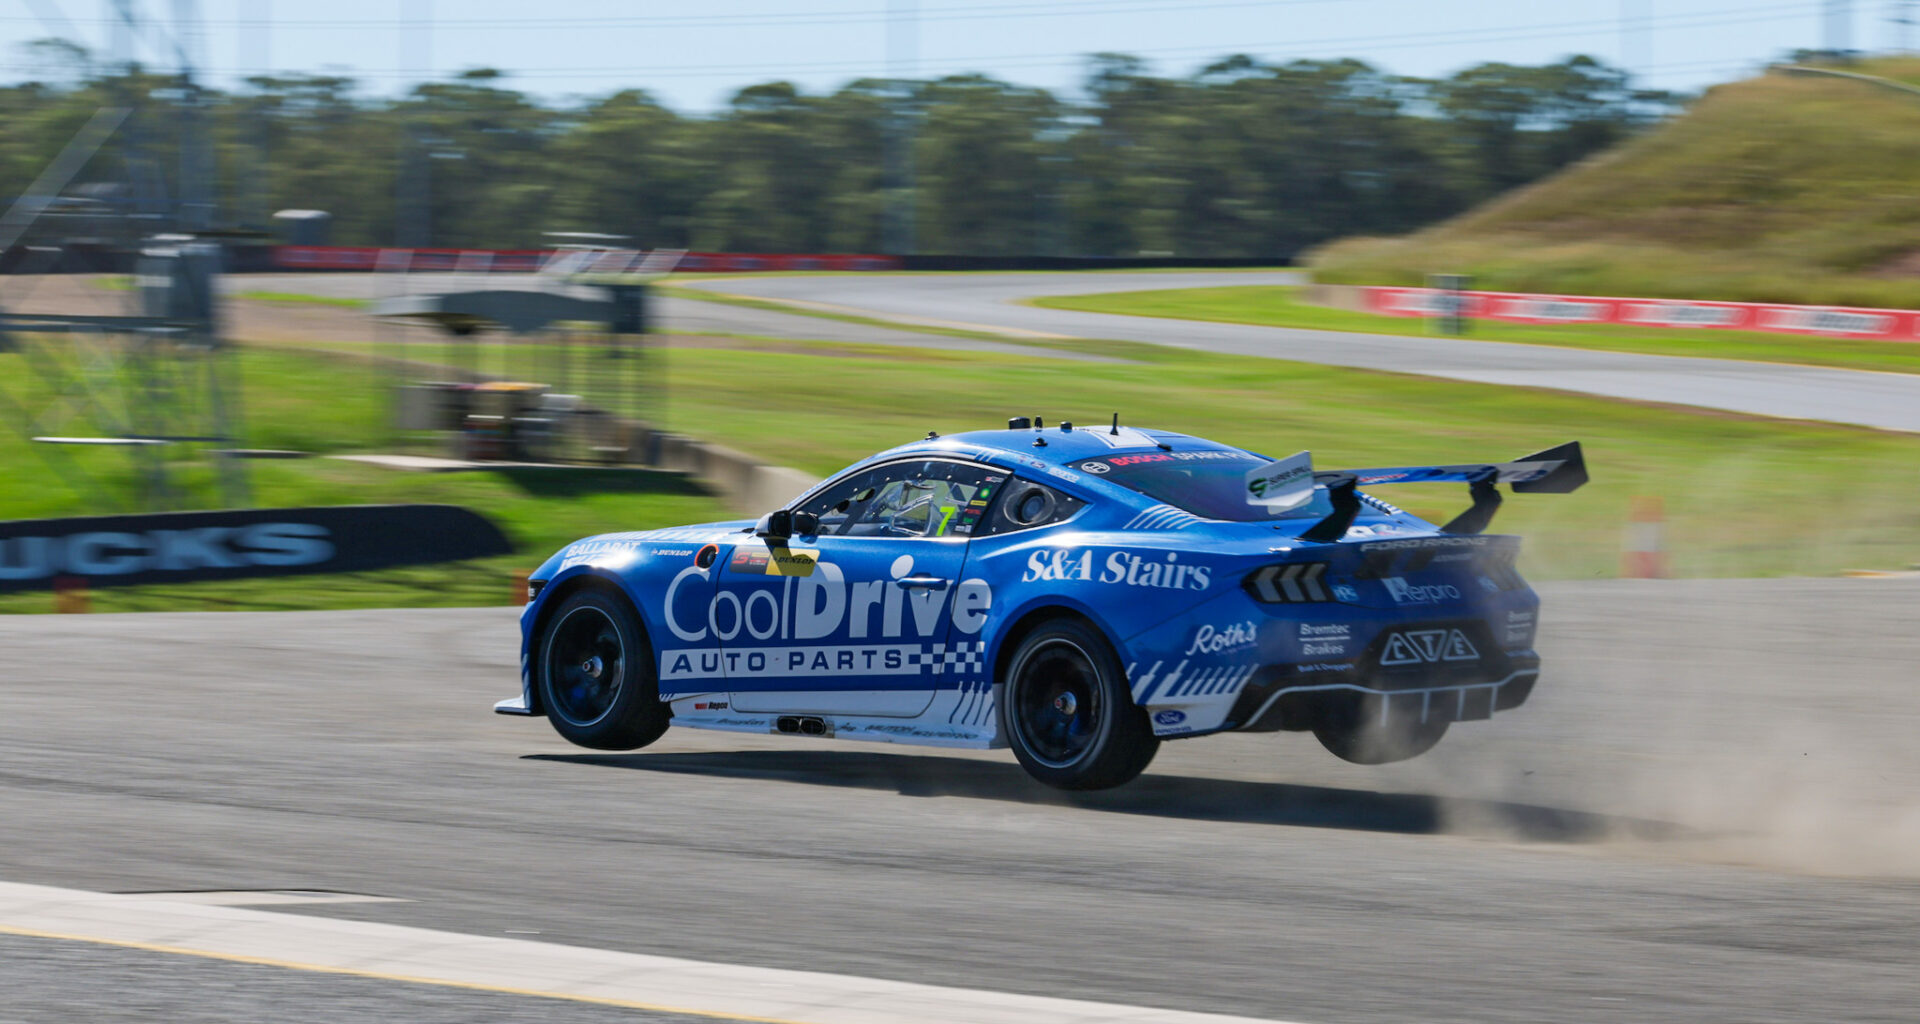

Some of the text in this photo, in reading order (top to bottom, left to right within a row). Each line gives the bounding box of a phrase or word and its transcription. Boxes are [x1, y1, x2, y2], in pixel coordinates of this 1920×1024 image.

[1109, 454, 1174, 466] BOSCH
[936, 506, 956, 537] 7
[1361, 537, 1489, 552] FORD RACING
[779, 556, 813, 565] DUNLOP
[1021, 549, 1211, 591] S&A Stairs
[664, 554, 992, 641] CoolDrive
[1186, 620, 1257, 656] Roth's
[1300, 623, 1350, 636] Bremtec
[1303, 643, 1344, 655] Brakes
[670, 649, 902, 673] AUTO PARTS
